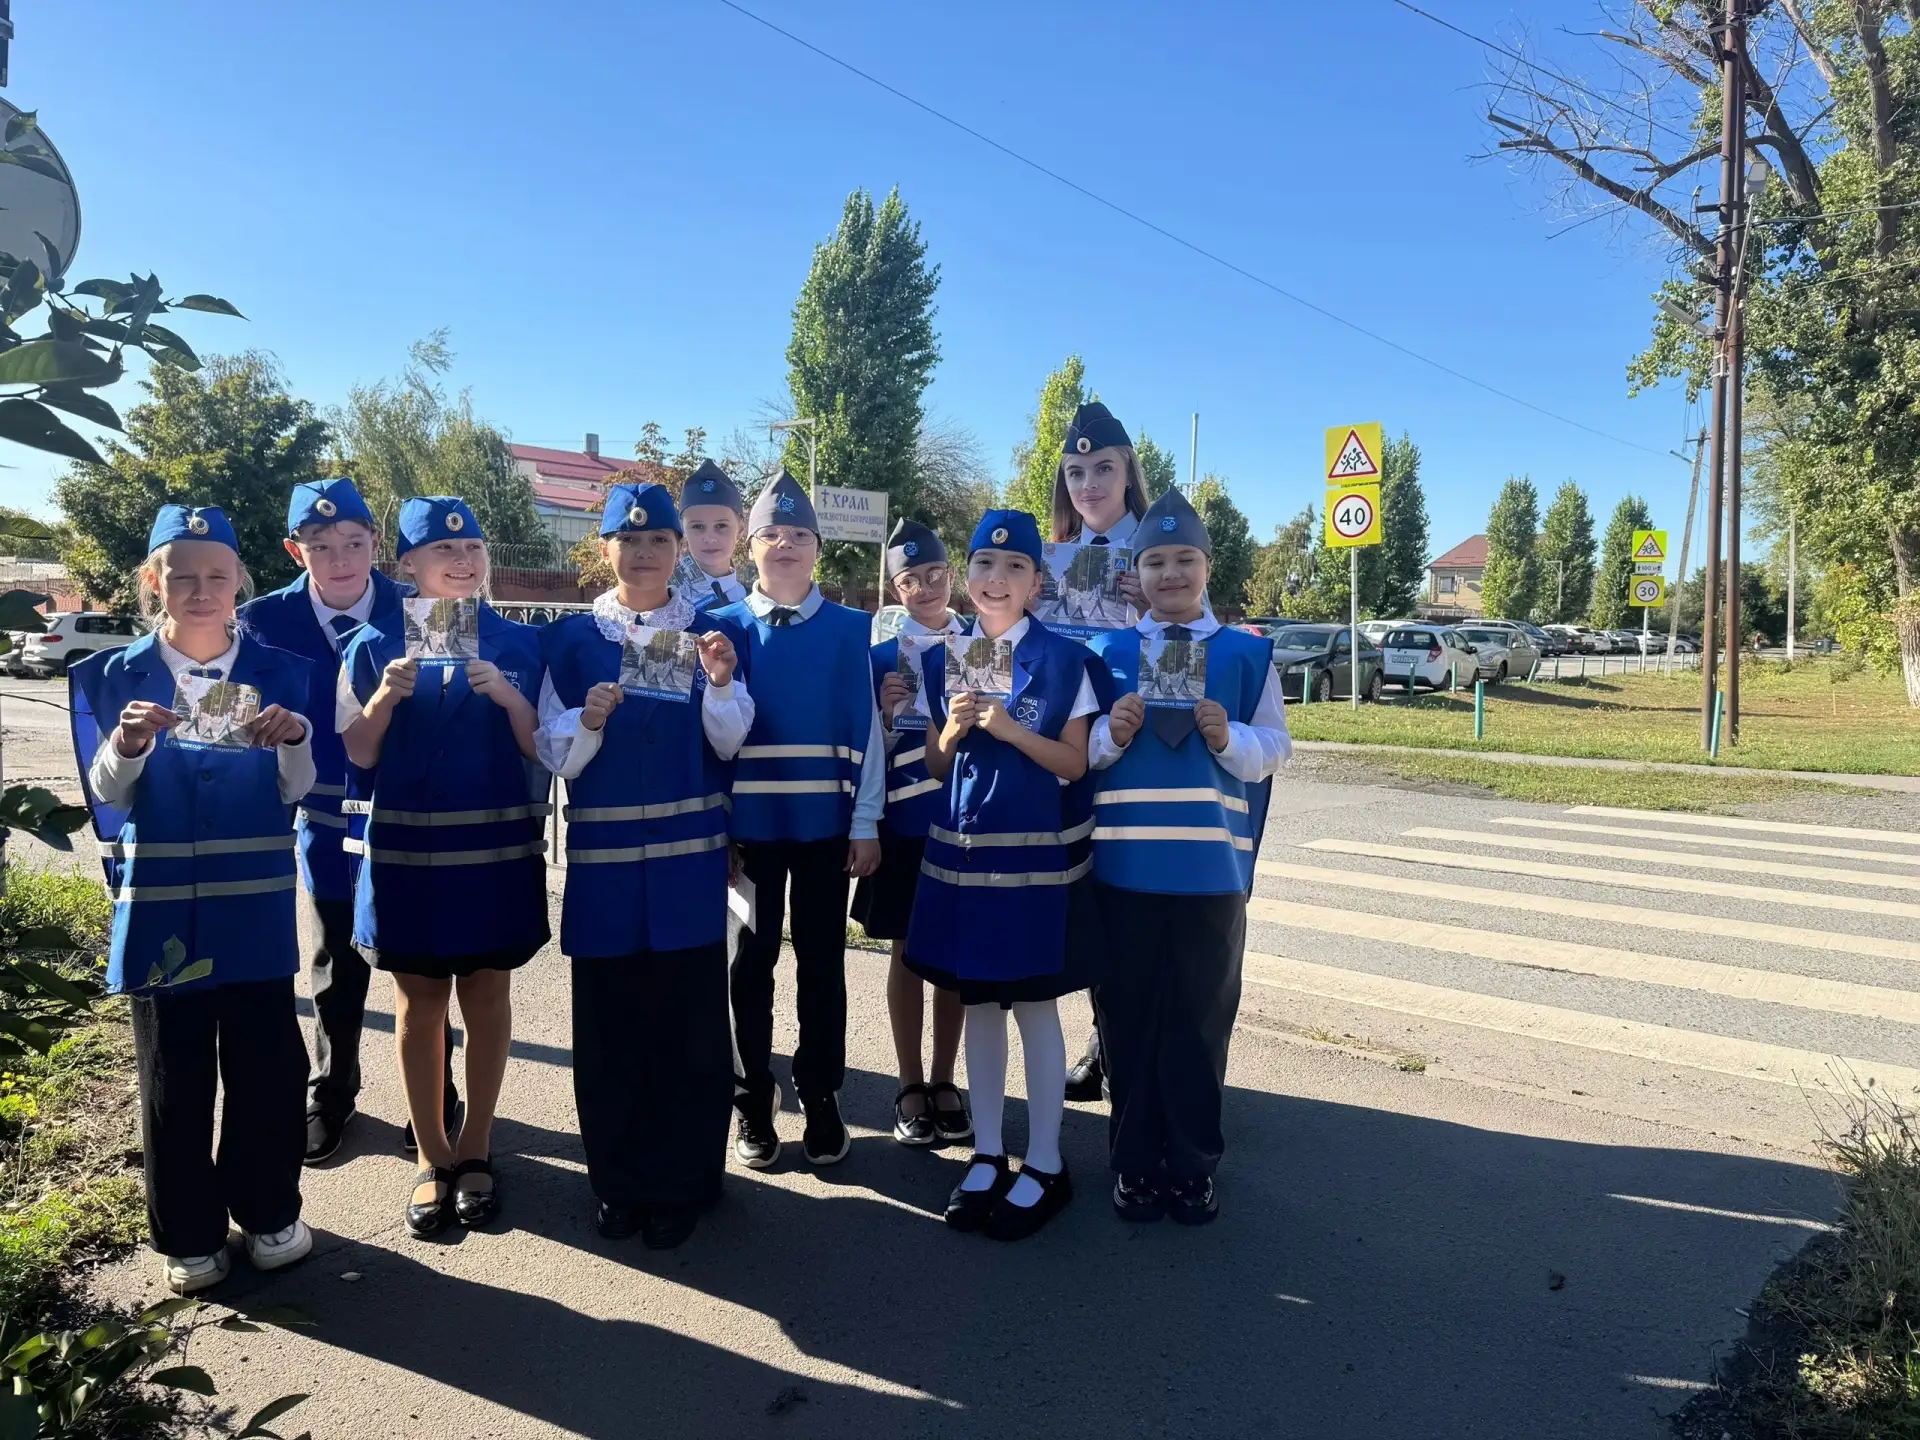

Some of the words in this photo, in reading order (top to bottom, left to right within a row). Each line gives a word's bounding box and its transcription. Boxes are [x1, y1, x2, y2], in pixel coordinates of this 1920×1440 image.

[832, 493, 869, 511] ХРАМ
[1339, 507, 1366, 526] 40
[1640, 586, 1655, 597] 30
[1045, 625, 1085, 635] шеход-на
[1022, 697, 1038, 707] ЮИД
[898, 717, 927, 726] Пешехо
